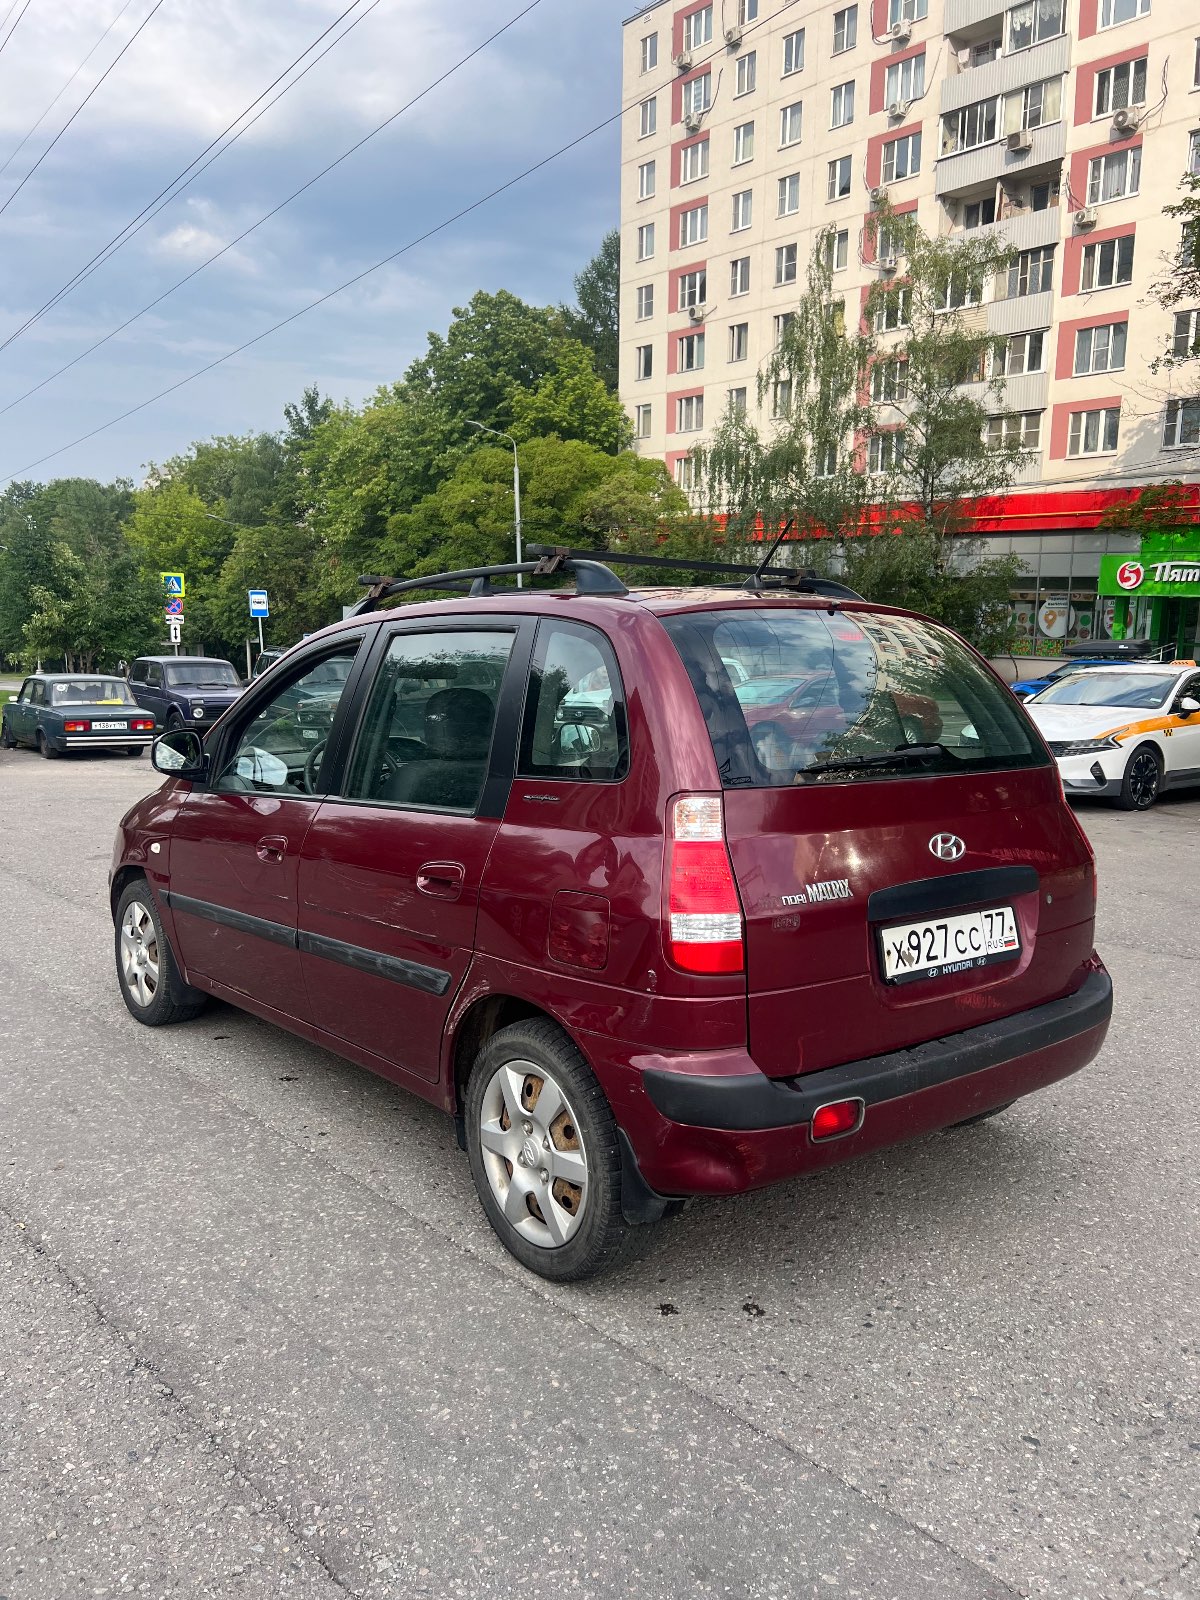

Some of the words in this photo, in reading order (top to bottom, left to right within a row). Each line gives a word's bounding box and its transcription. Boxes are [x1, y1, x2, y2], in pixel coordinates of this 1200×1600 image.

[806, 879, 854, 903] MATRIX
[984, 911, 1005, 939] 77
[988, 938, 1004, 949] RUS
[943, 960, 973, 974] HYUNDAI
